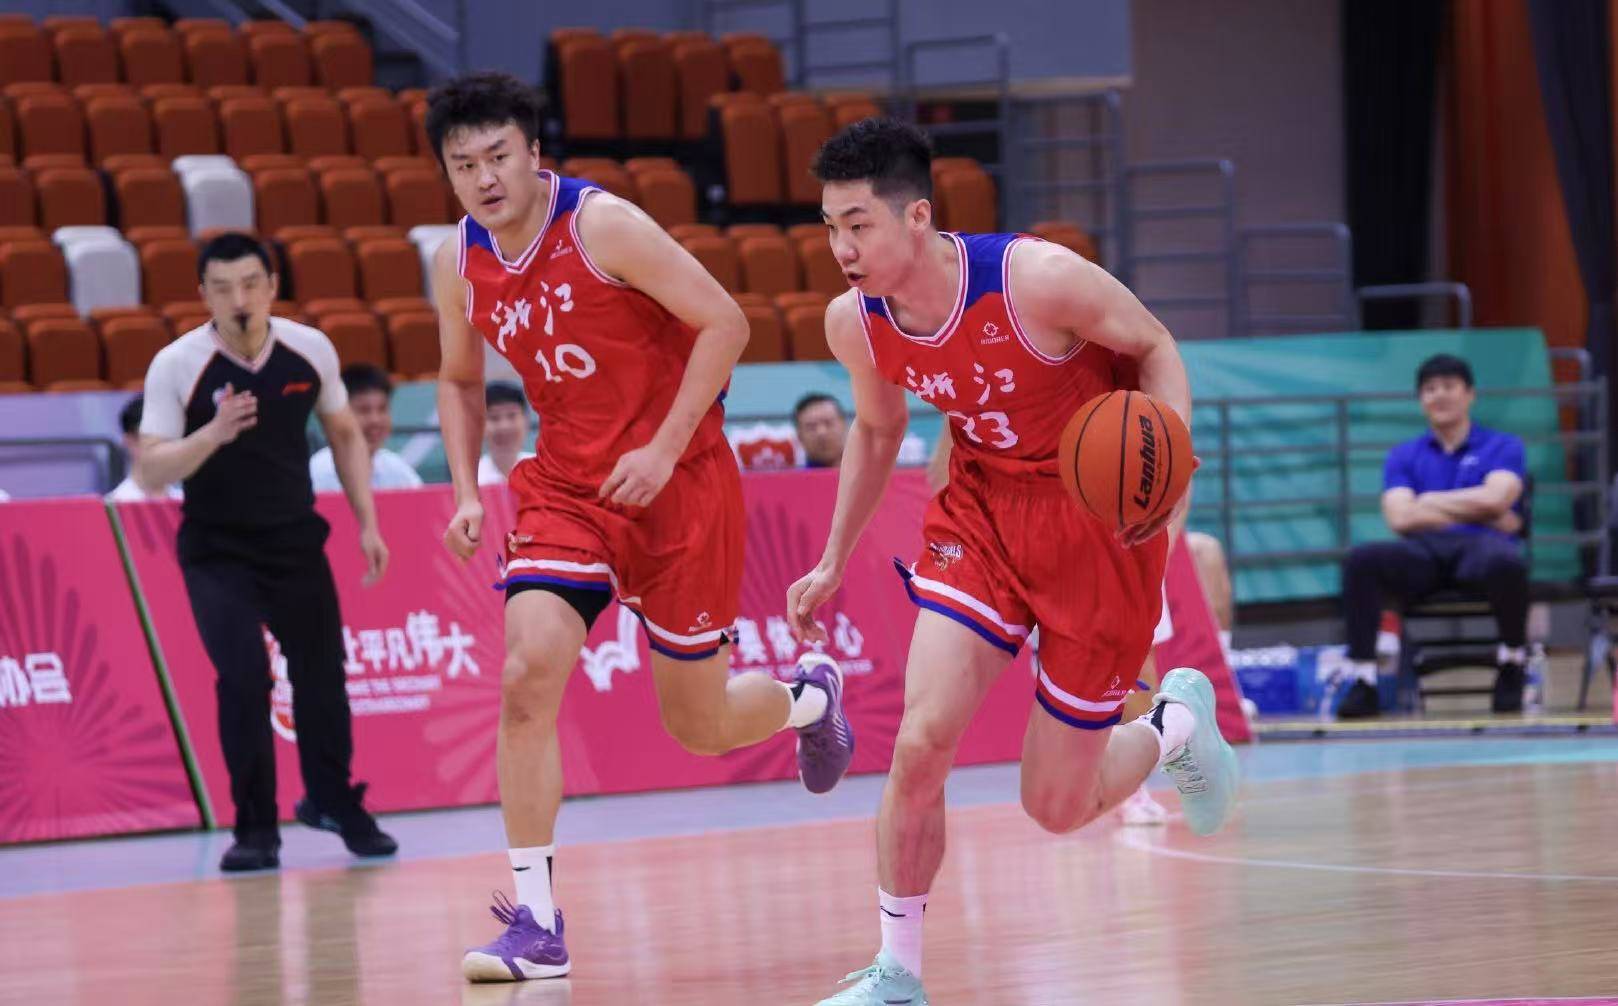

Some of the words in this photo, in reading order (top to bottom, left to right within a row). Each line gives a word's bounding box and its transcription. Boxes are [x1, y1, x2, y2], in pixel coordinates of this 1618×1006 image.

[490, 281, 575, 352] 浙江
[535, 343, 597, 383] 10
[905, 362, 1016, 405] 浙江
[1133, 413, 1156, 510] Lanhua
